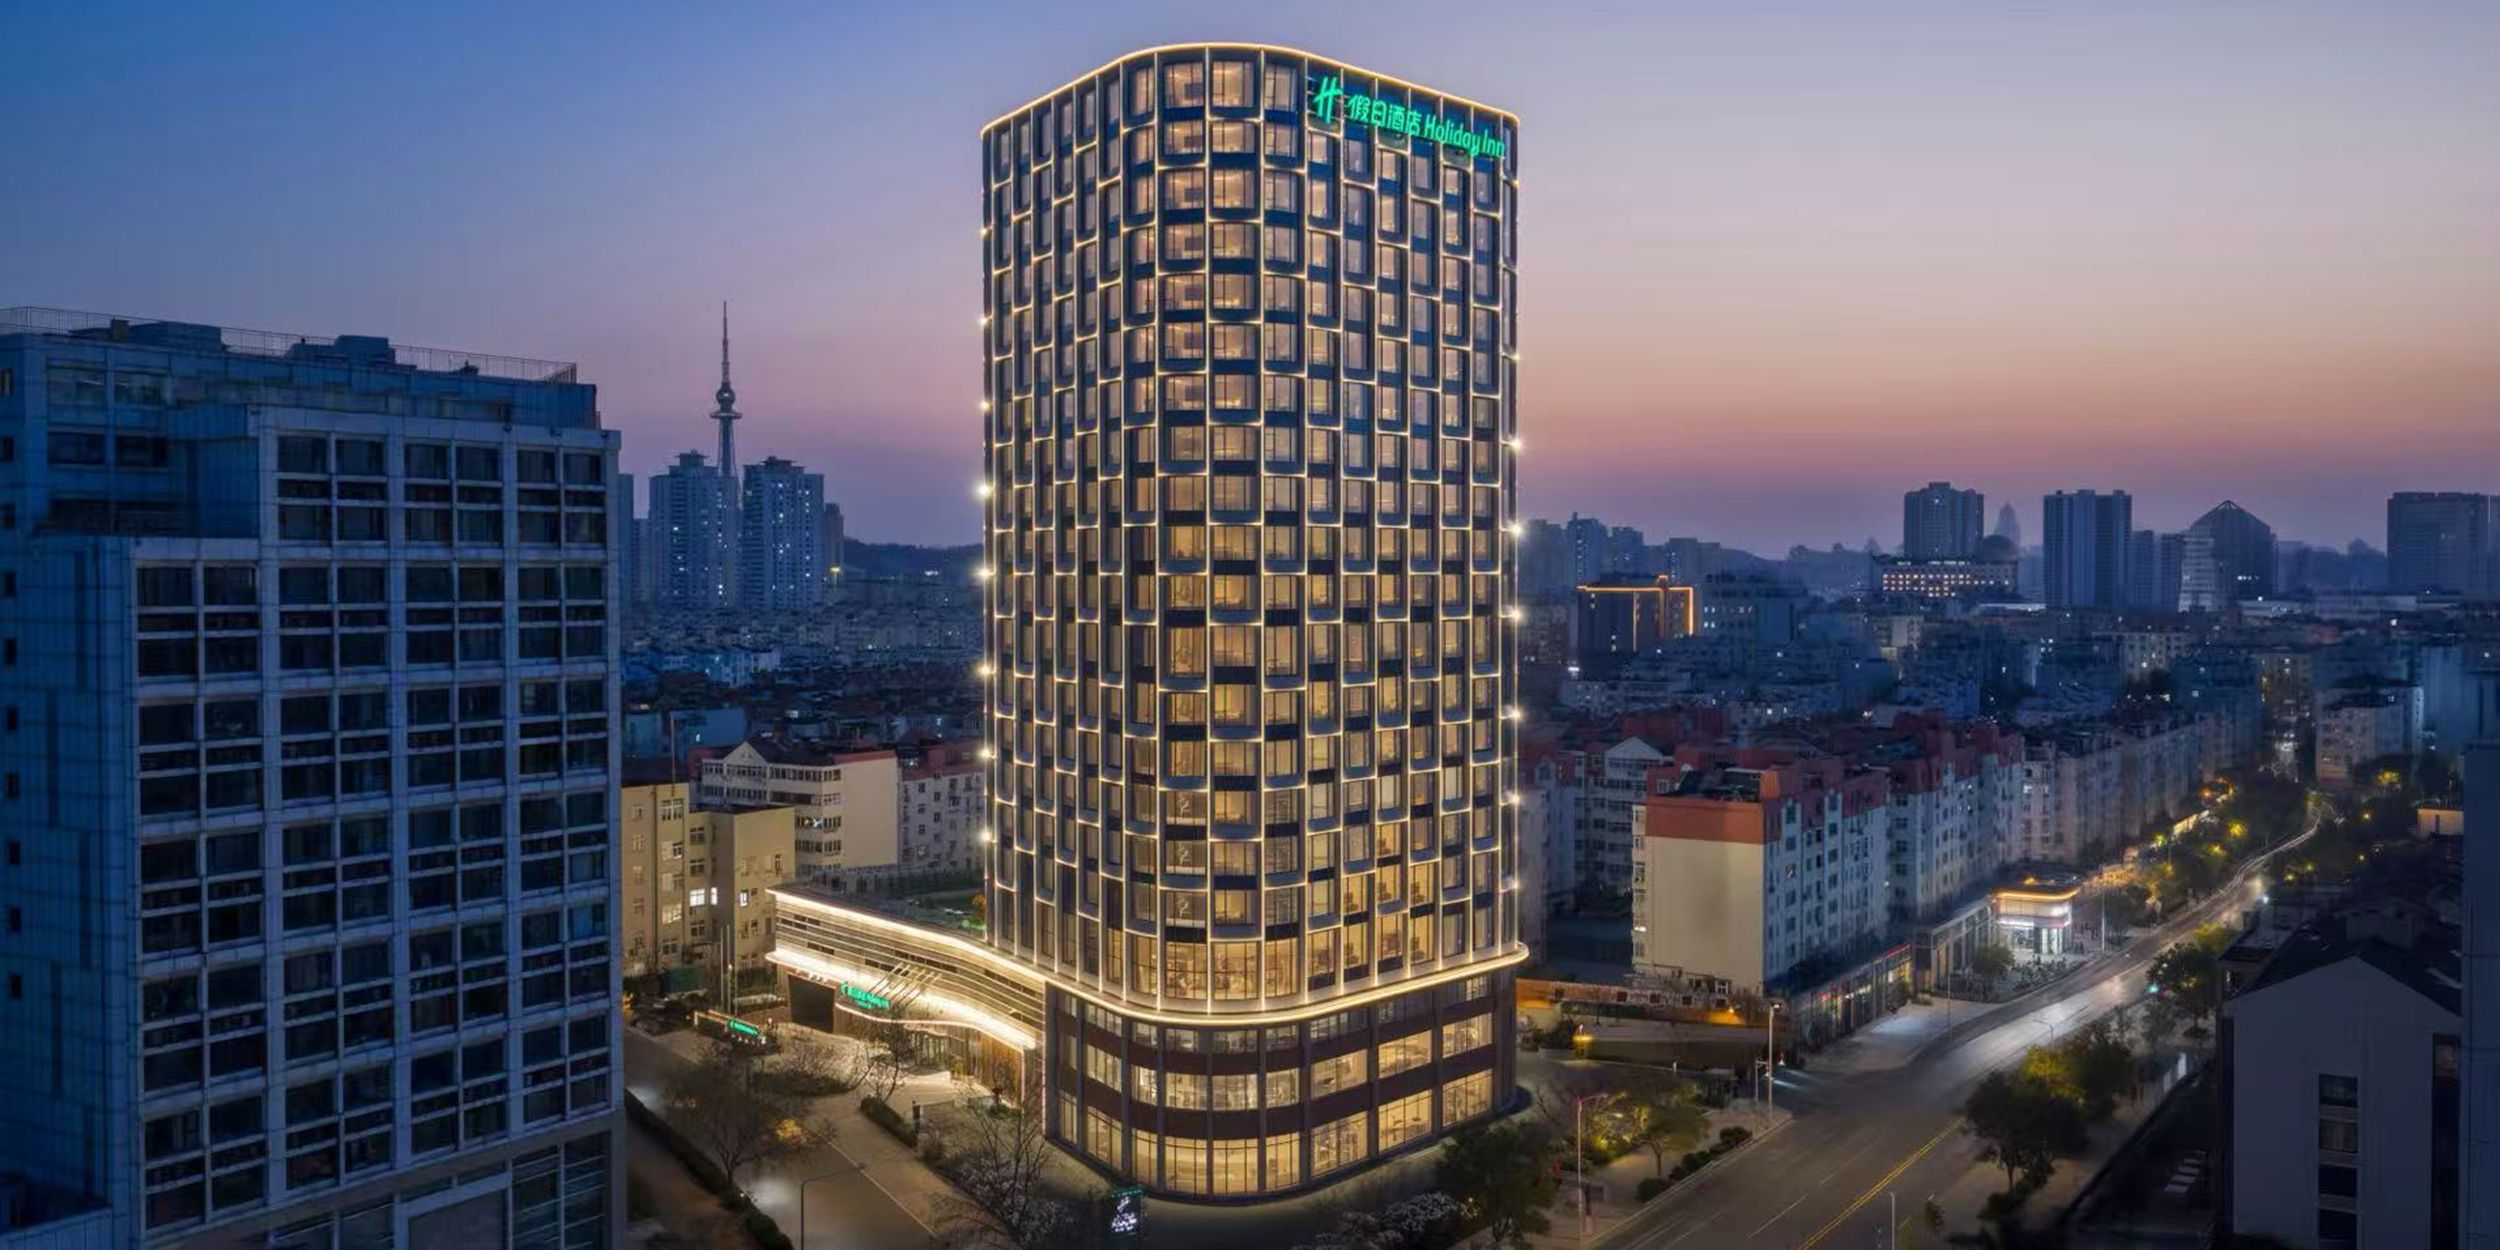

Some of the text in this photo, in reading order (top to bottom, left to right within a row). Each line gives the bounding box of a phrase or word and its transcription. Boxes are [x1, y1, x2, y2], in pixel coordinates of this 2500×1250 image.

[1348, 94, 1421, 136] 假日酒店
[1423, 113, 1481, 155] Holiday
[1483, 129, 1506, 158] Inn
